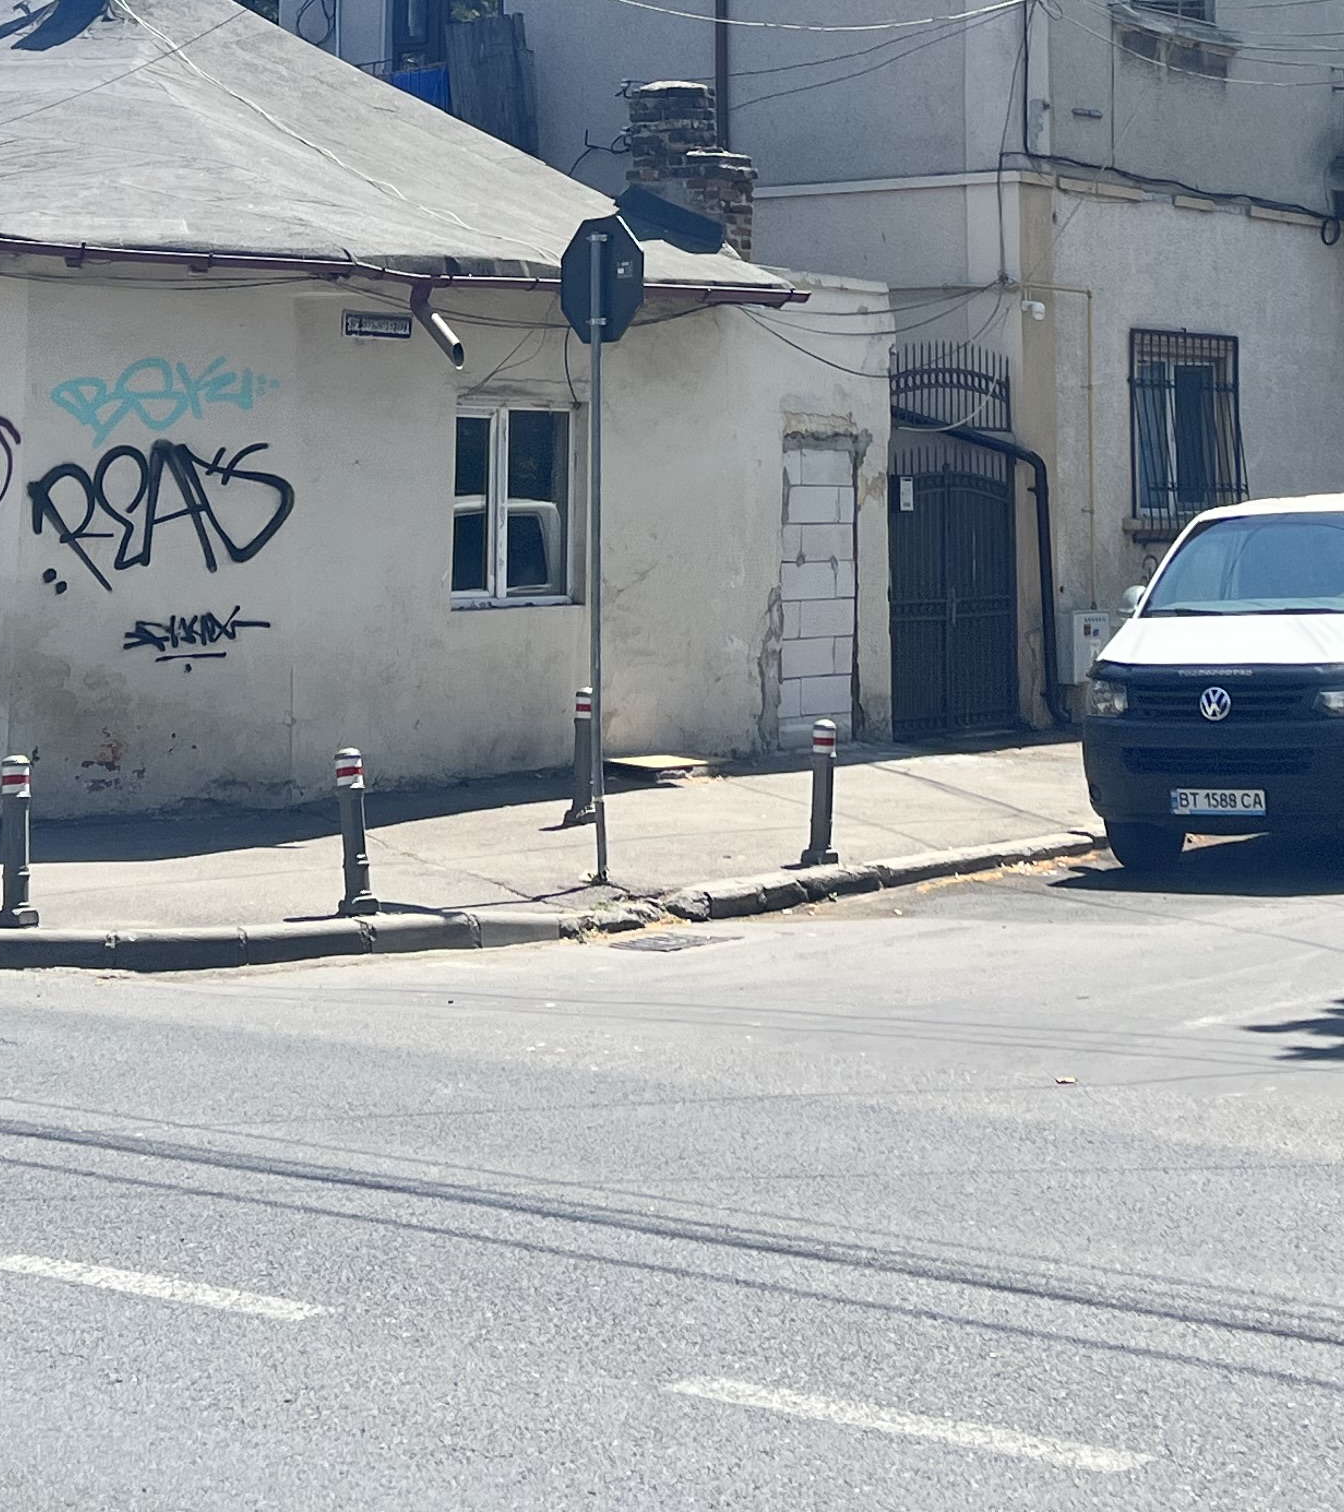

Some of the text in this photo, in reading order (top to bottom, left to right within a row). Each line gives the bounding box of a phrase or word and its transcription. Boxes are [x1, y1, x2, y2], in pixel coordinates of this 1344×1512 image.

[1179, 792, 1263, 809] BT 1588 CA
